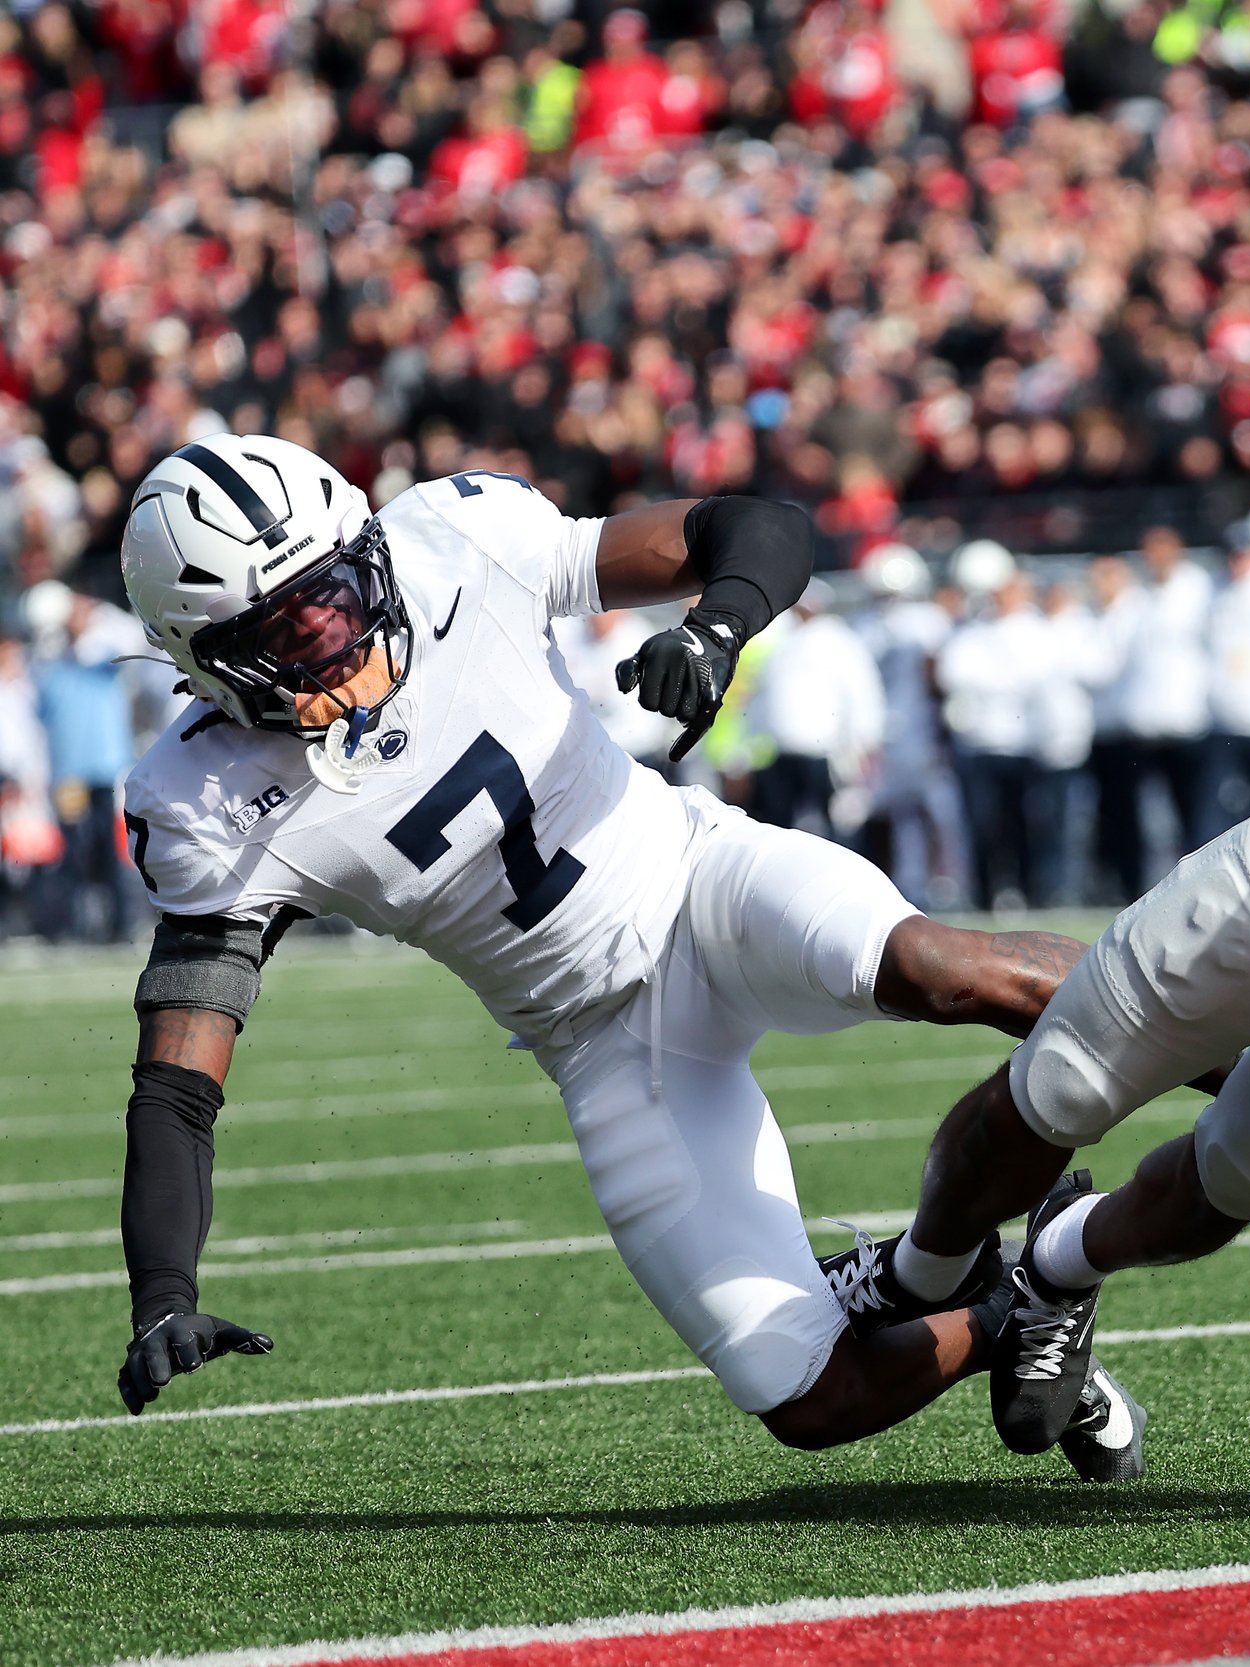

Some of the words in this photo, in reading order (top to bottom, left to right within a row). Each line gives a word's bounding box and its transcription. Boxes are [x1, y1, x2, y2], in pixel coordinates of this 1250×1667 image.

[261, 552, 289, 575] PENN
[287, 534, 316, 557] STATE
[124, 808, 158, 894] 7
[385, 730, 587, 933] 7
